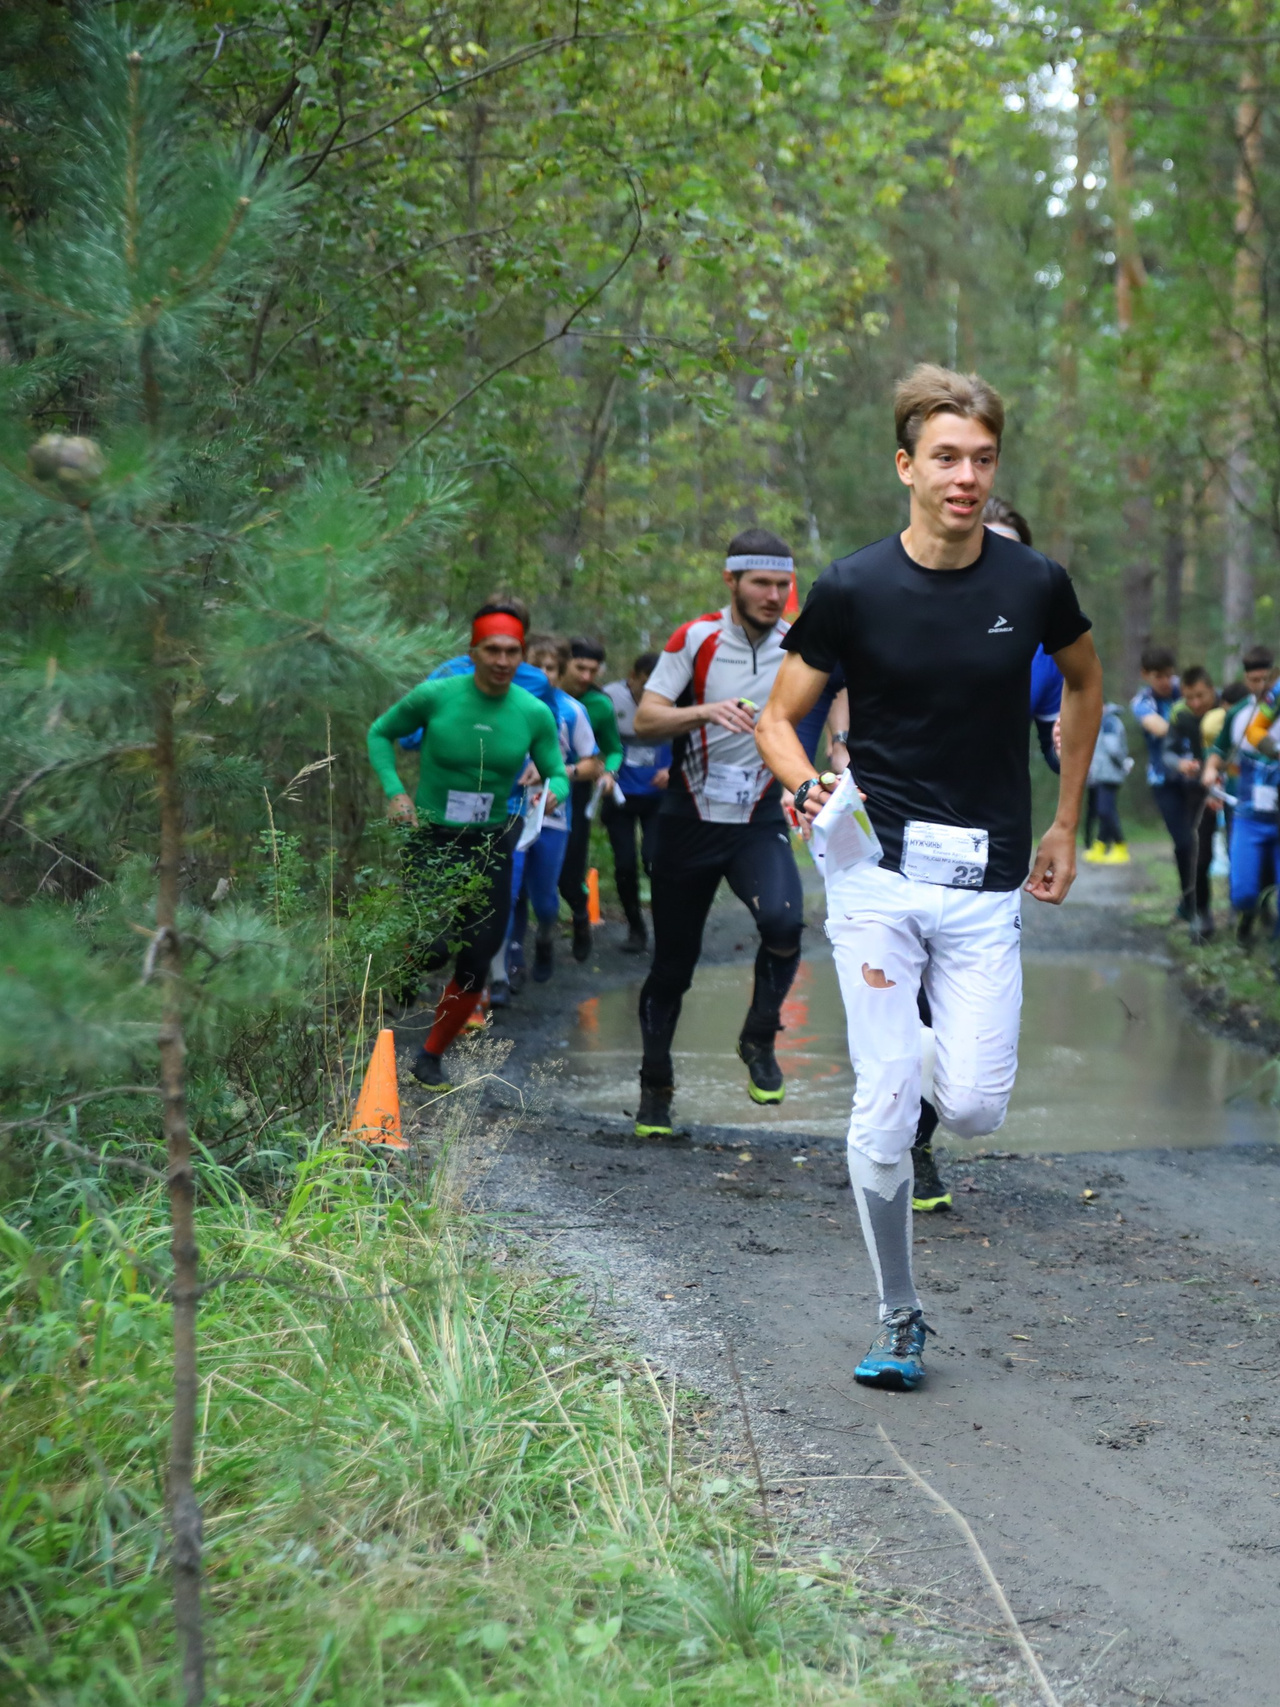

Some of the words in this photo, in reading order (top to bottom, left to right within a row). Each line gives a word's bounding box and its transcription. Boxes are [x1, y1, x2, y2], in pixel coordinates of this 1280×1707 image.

[988, 626, 1014, 634] DEMIX
[736, 789, 750, 806] 12
[909, 839, 943, 849] МУЖЧИНЫ
[952, 866, 983, 886] 22
